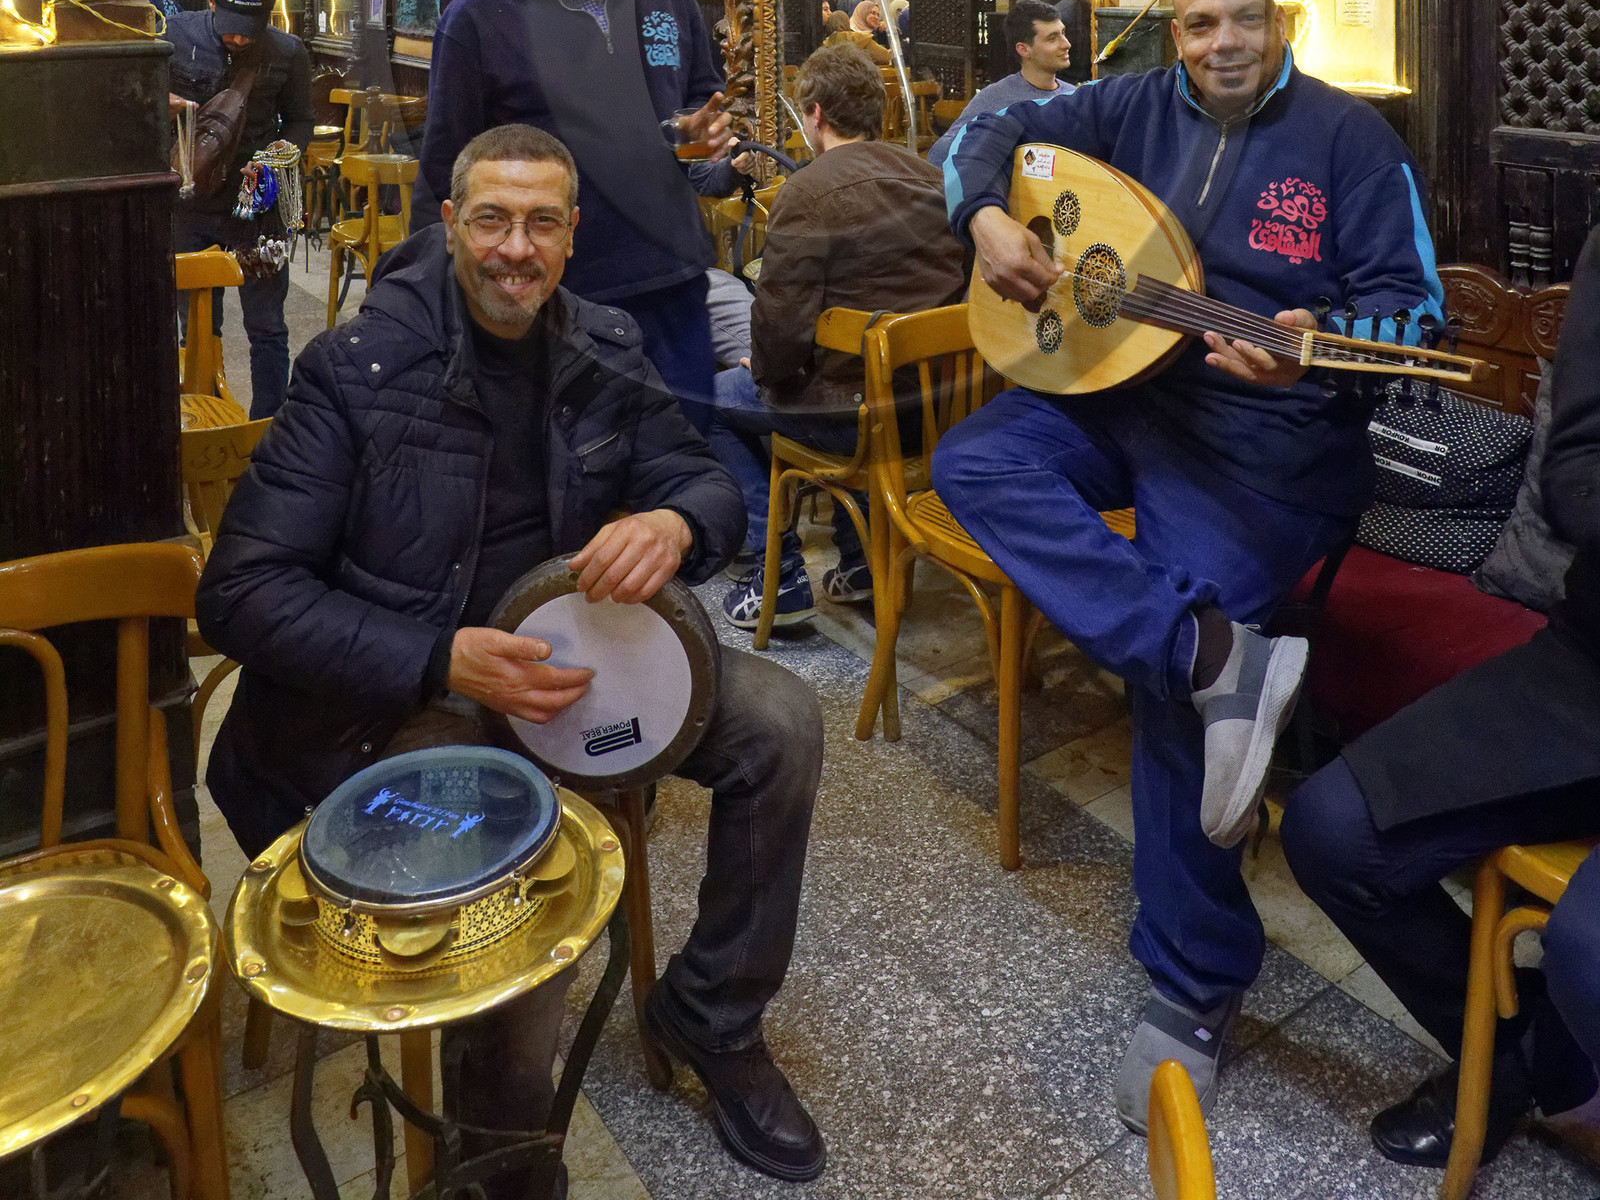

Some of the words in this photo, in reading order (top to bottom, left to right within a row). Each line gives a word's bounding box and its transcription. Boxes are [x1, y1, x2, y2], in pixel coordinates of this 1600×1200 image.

[1382, 428, 1409, 443] KONFOR
[582, 728, 602, 741] BEAT
[603, 720, 631, 735] POWER
